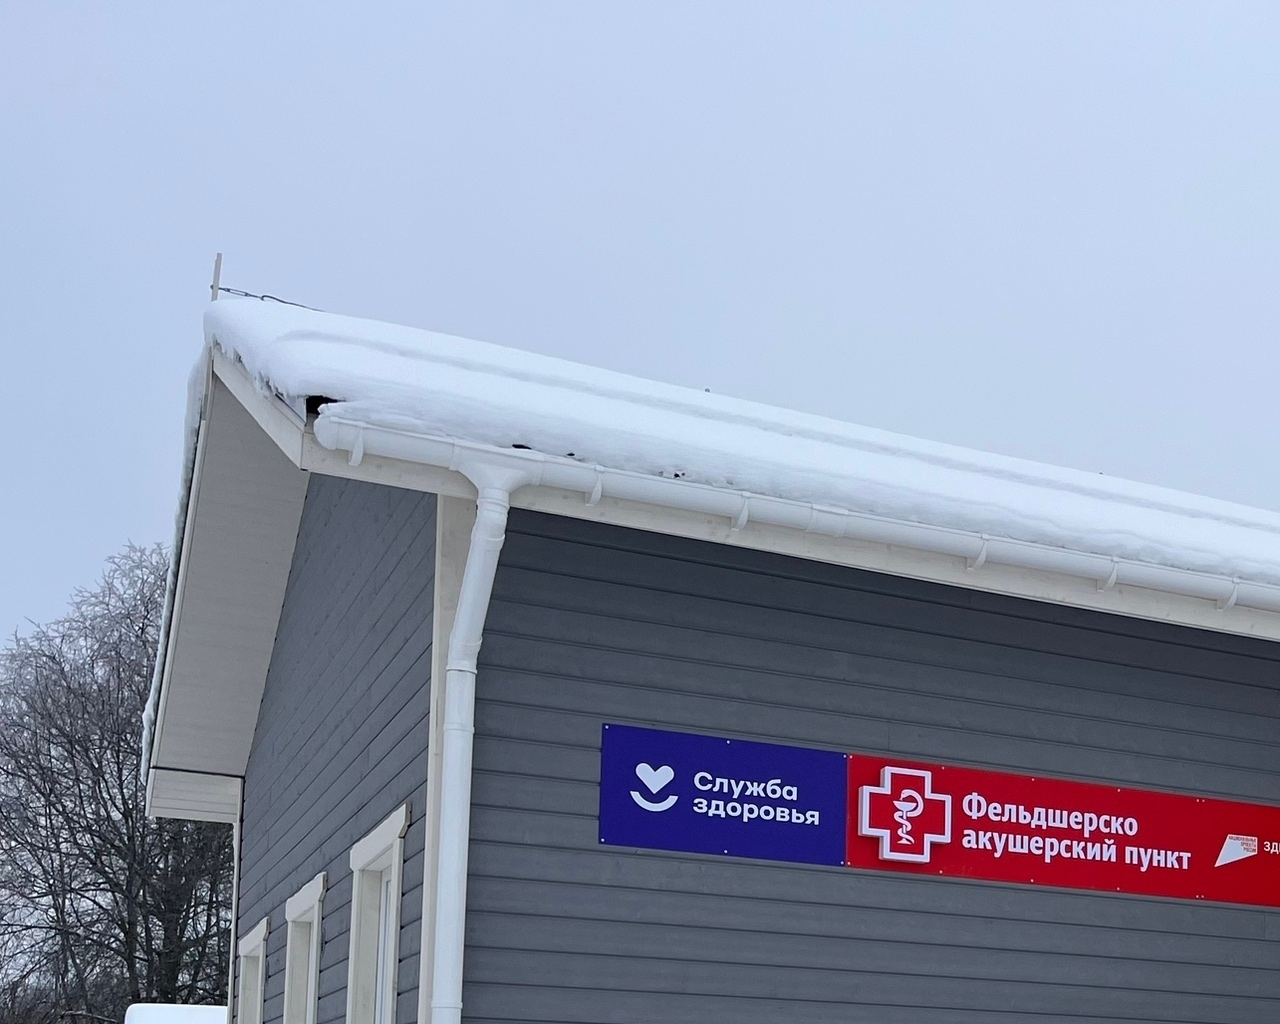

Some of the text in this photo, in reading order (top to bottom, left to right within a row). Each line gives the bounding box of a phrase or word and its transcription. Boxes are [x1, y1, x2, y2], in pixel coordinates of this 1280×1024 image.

[693, 771, 799, 801] Служба
[692, 797, 820, 826] здоровья
[962, 792, 1138, 837] Фельдшерско
[962, 827, 1191, 874] акушерский пункт
